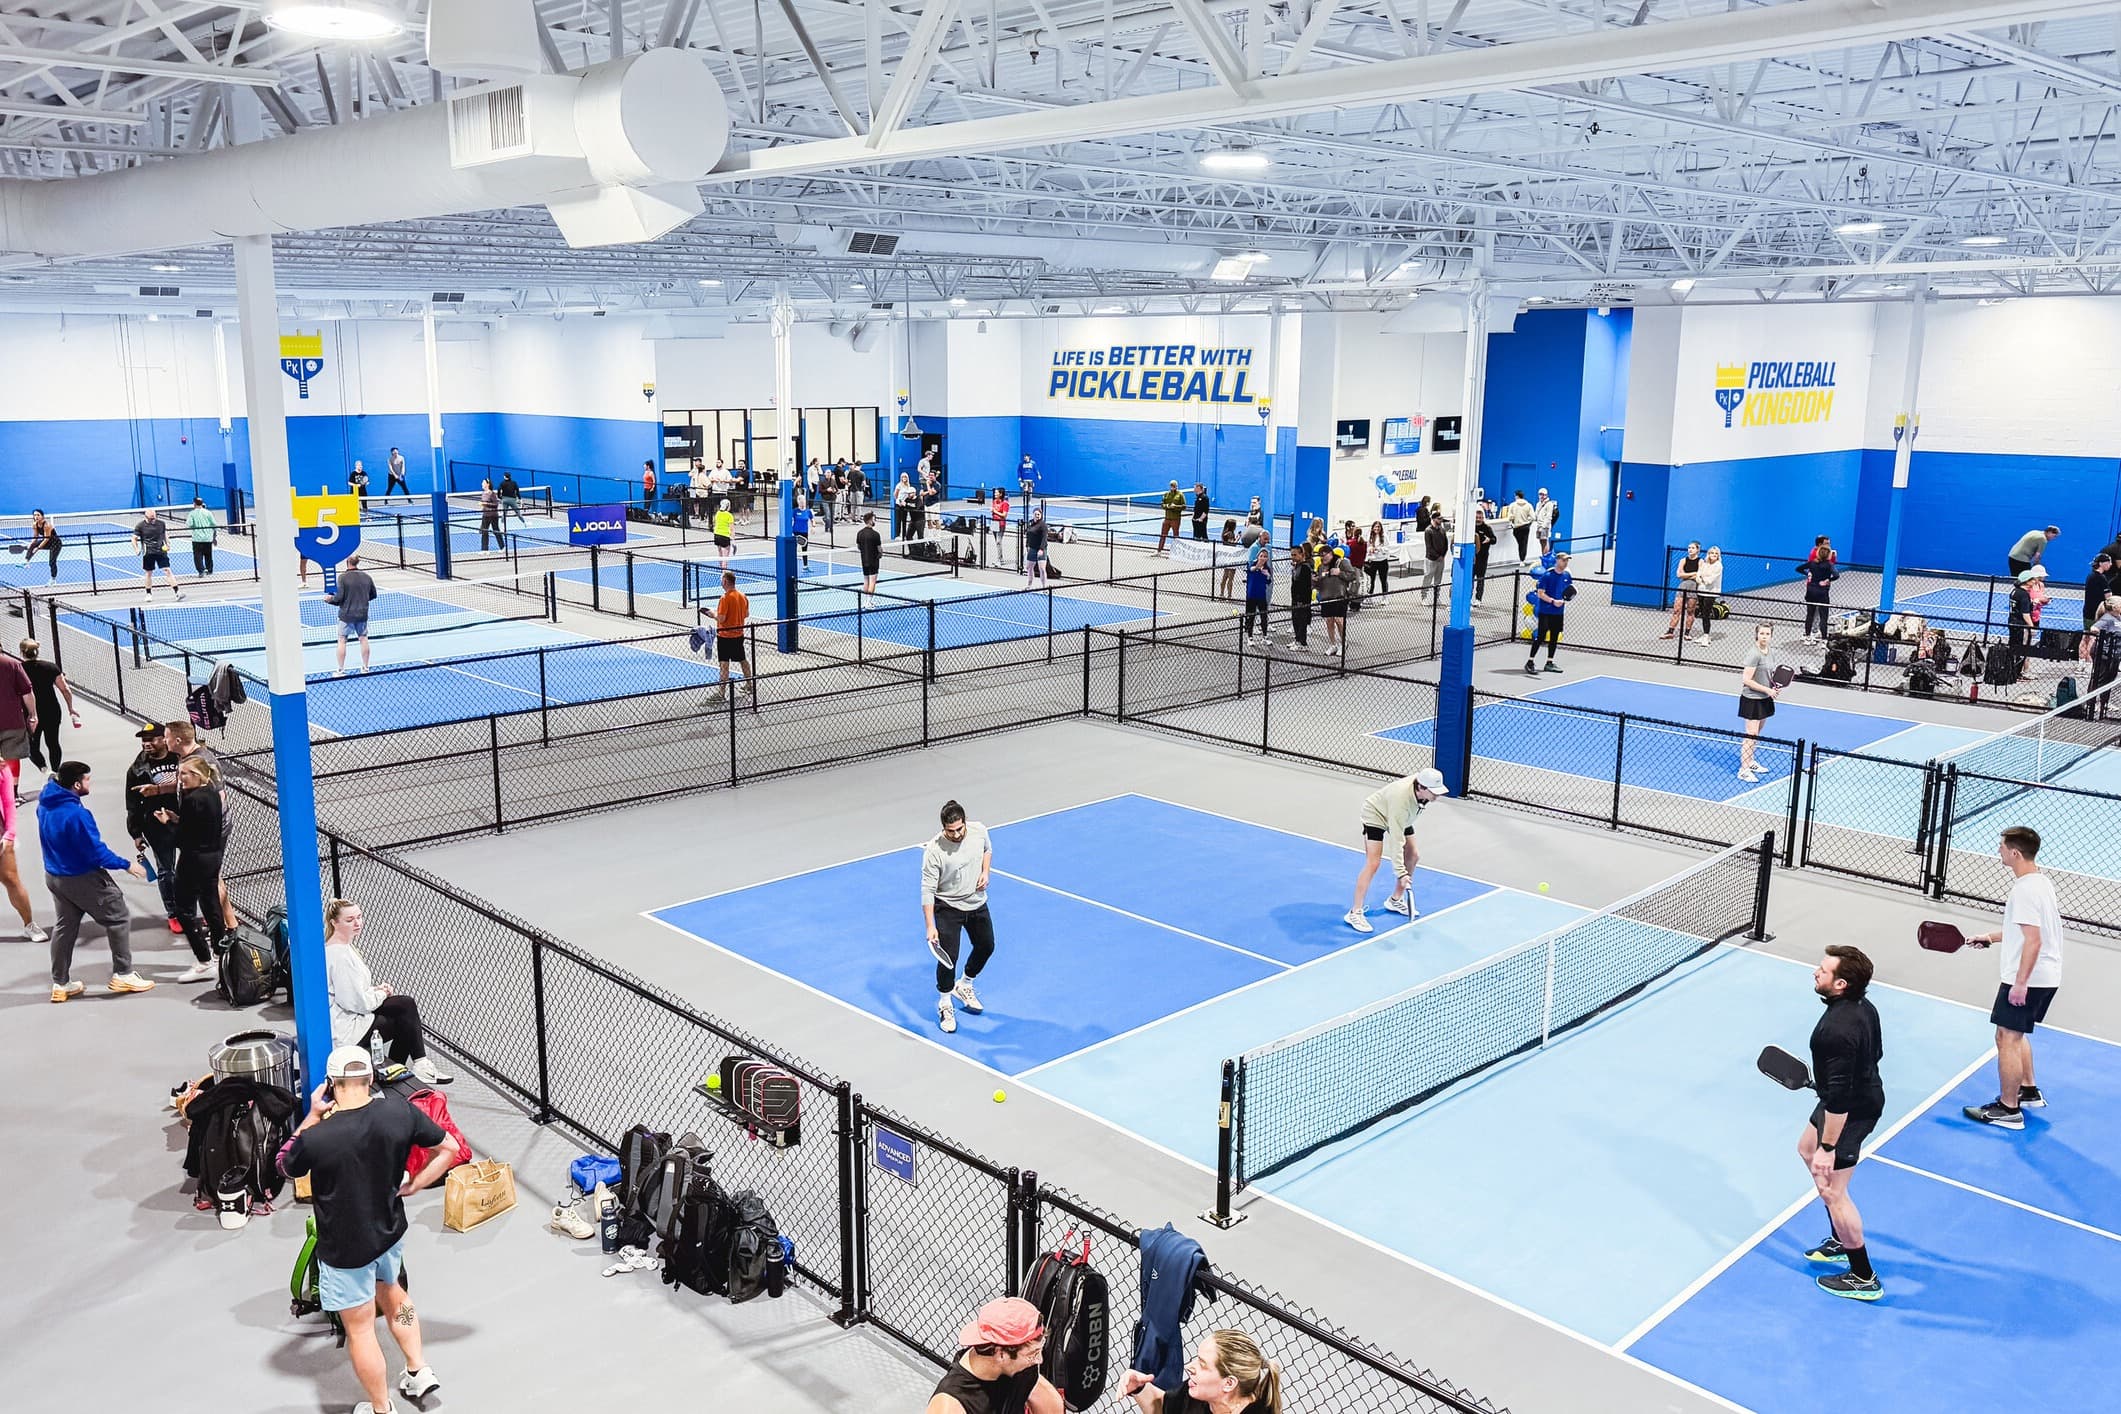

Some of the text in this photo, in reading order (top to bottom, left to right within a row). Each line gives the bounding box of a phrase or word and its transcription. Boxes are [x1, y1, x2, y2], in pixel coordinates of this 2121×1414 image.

[285, 360, 299, 375] PK
[1053, 345, 1252, 366] LIFE IS BETTER WITH
[1049, 369, 1254, 404] PICKLEBALL
[1748, 361, 1836, 389] PICKLEBALL
[1741, 389, 1834, 427] KINGDOM
[315, 507, 340, 546] 5
[582, 520, 622, 532] JOOLA
[878, 1140, 911, 1163] ADVANCED
[1087, 1302, 1103, 1362] CRBN
